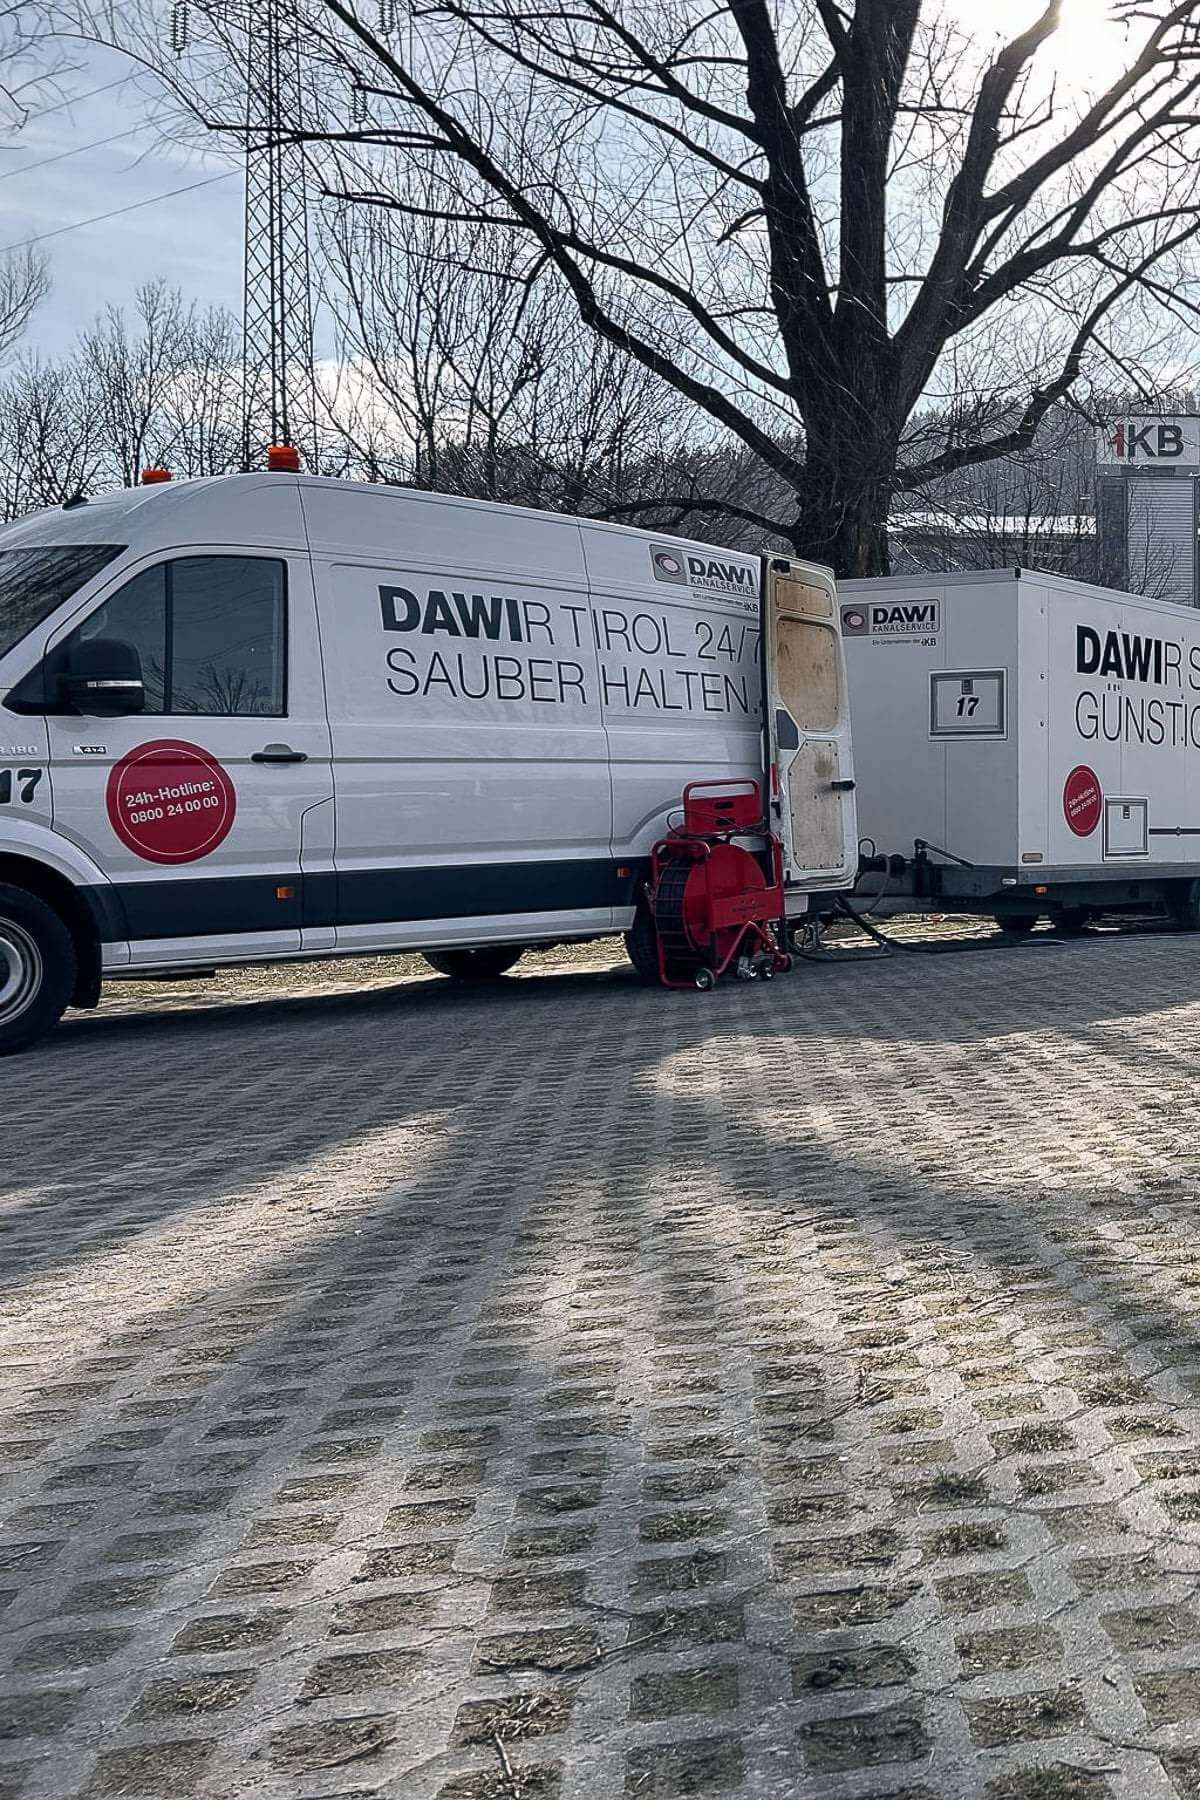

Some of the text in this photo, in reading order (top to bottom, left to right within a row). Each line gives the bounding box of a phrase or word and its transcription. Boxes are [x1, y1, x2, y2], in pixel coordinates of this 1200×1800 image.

[1111, 423, 1184, 457] IKB
[687, 557, 755, 587] DAWI
[690, 576, 757, 596] KANALSERVICE
[378, 584, 760, 664] DAWIR TIROL 24/7
[872, 604, 936, 625] DAWI
[872, 622, 936, 633] KANALSERVICE
[1076, 624, 1182, 688] DAWIR
[386, 648, 758, 714] SAUBER HALTEN.
[956, 696, 980, 717] 17
[0, 768, 43, 804] 17
[125, 780, 216, 807] 24h-Hotline:
[130, 795, 219, 824] 0800 24 00 00
